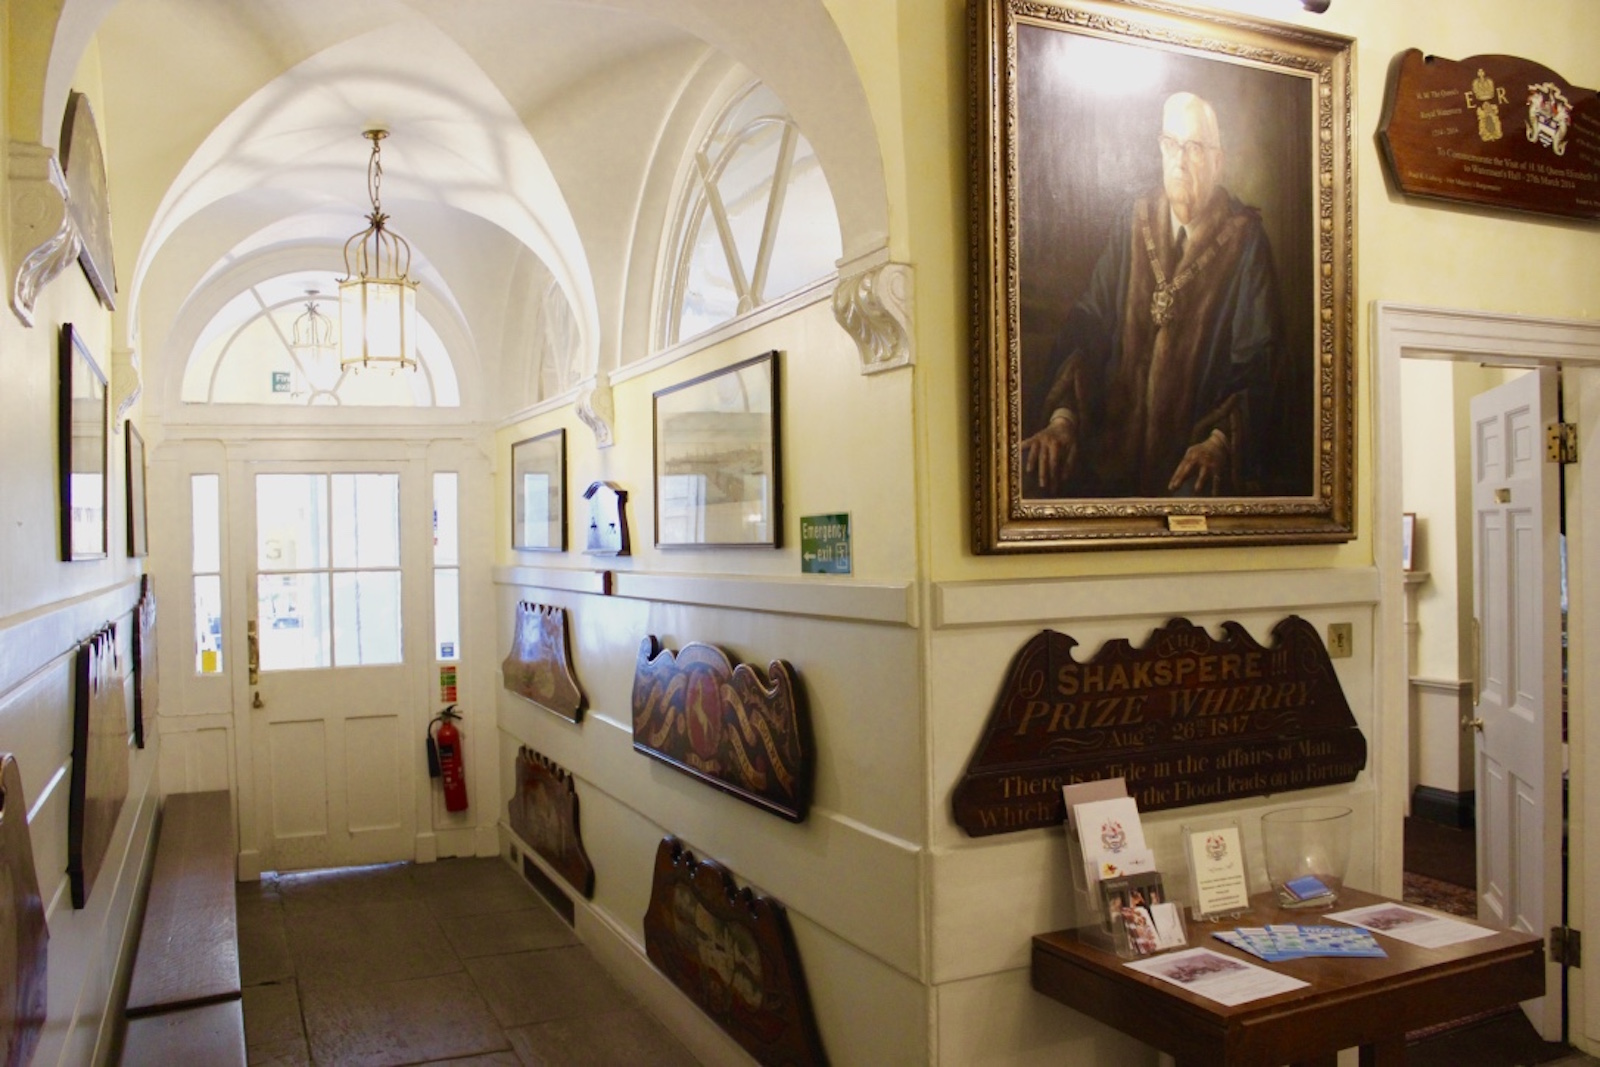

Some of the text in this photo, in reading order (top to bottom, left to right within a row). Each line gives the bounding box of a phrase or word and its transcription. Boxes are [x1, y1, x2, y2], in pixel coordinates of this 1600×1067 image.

[1463, 87, 1509, 109] E R
[1436, 147, 1445, 156] To
[1446, 148, 1493, 165] Commemorate
[1493, 157, 1503, 166] the
[1504, 158, 1519, 169] Visit
[1520, 161, 1527, 170] of
[1546, 166, 1565, 177] Queen
[1566, 169, 1593, 181] Elizabeth
[1508, 170, 1521, 180] Hall
[802, 523, 847, 542] Emergency
[816, 545, 832, 562] exit
[1057, 652, 1262, 696] SHAKSPERE
[1014, 694, 1148, 736] PRIZE
[1210, 714, 1249, 737] 1847
[1000, 774, 1062, 799] There
[1106, 763, 1146, 781] Tide
[1154, 758, 1170, 778] in
[1177, 755, 1209, 774] the
[1216, 748, 1273, 770] affairs
[1278, 744, 1293, 761] of
[1143, 786, 1170, 806] the
[1228, 775, 1267, 794] leads
[1270, 771, 1288, 786] on
[1290, 768, 1304, 783] to
